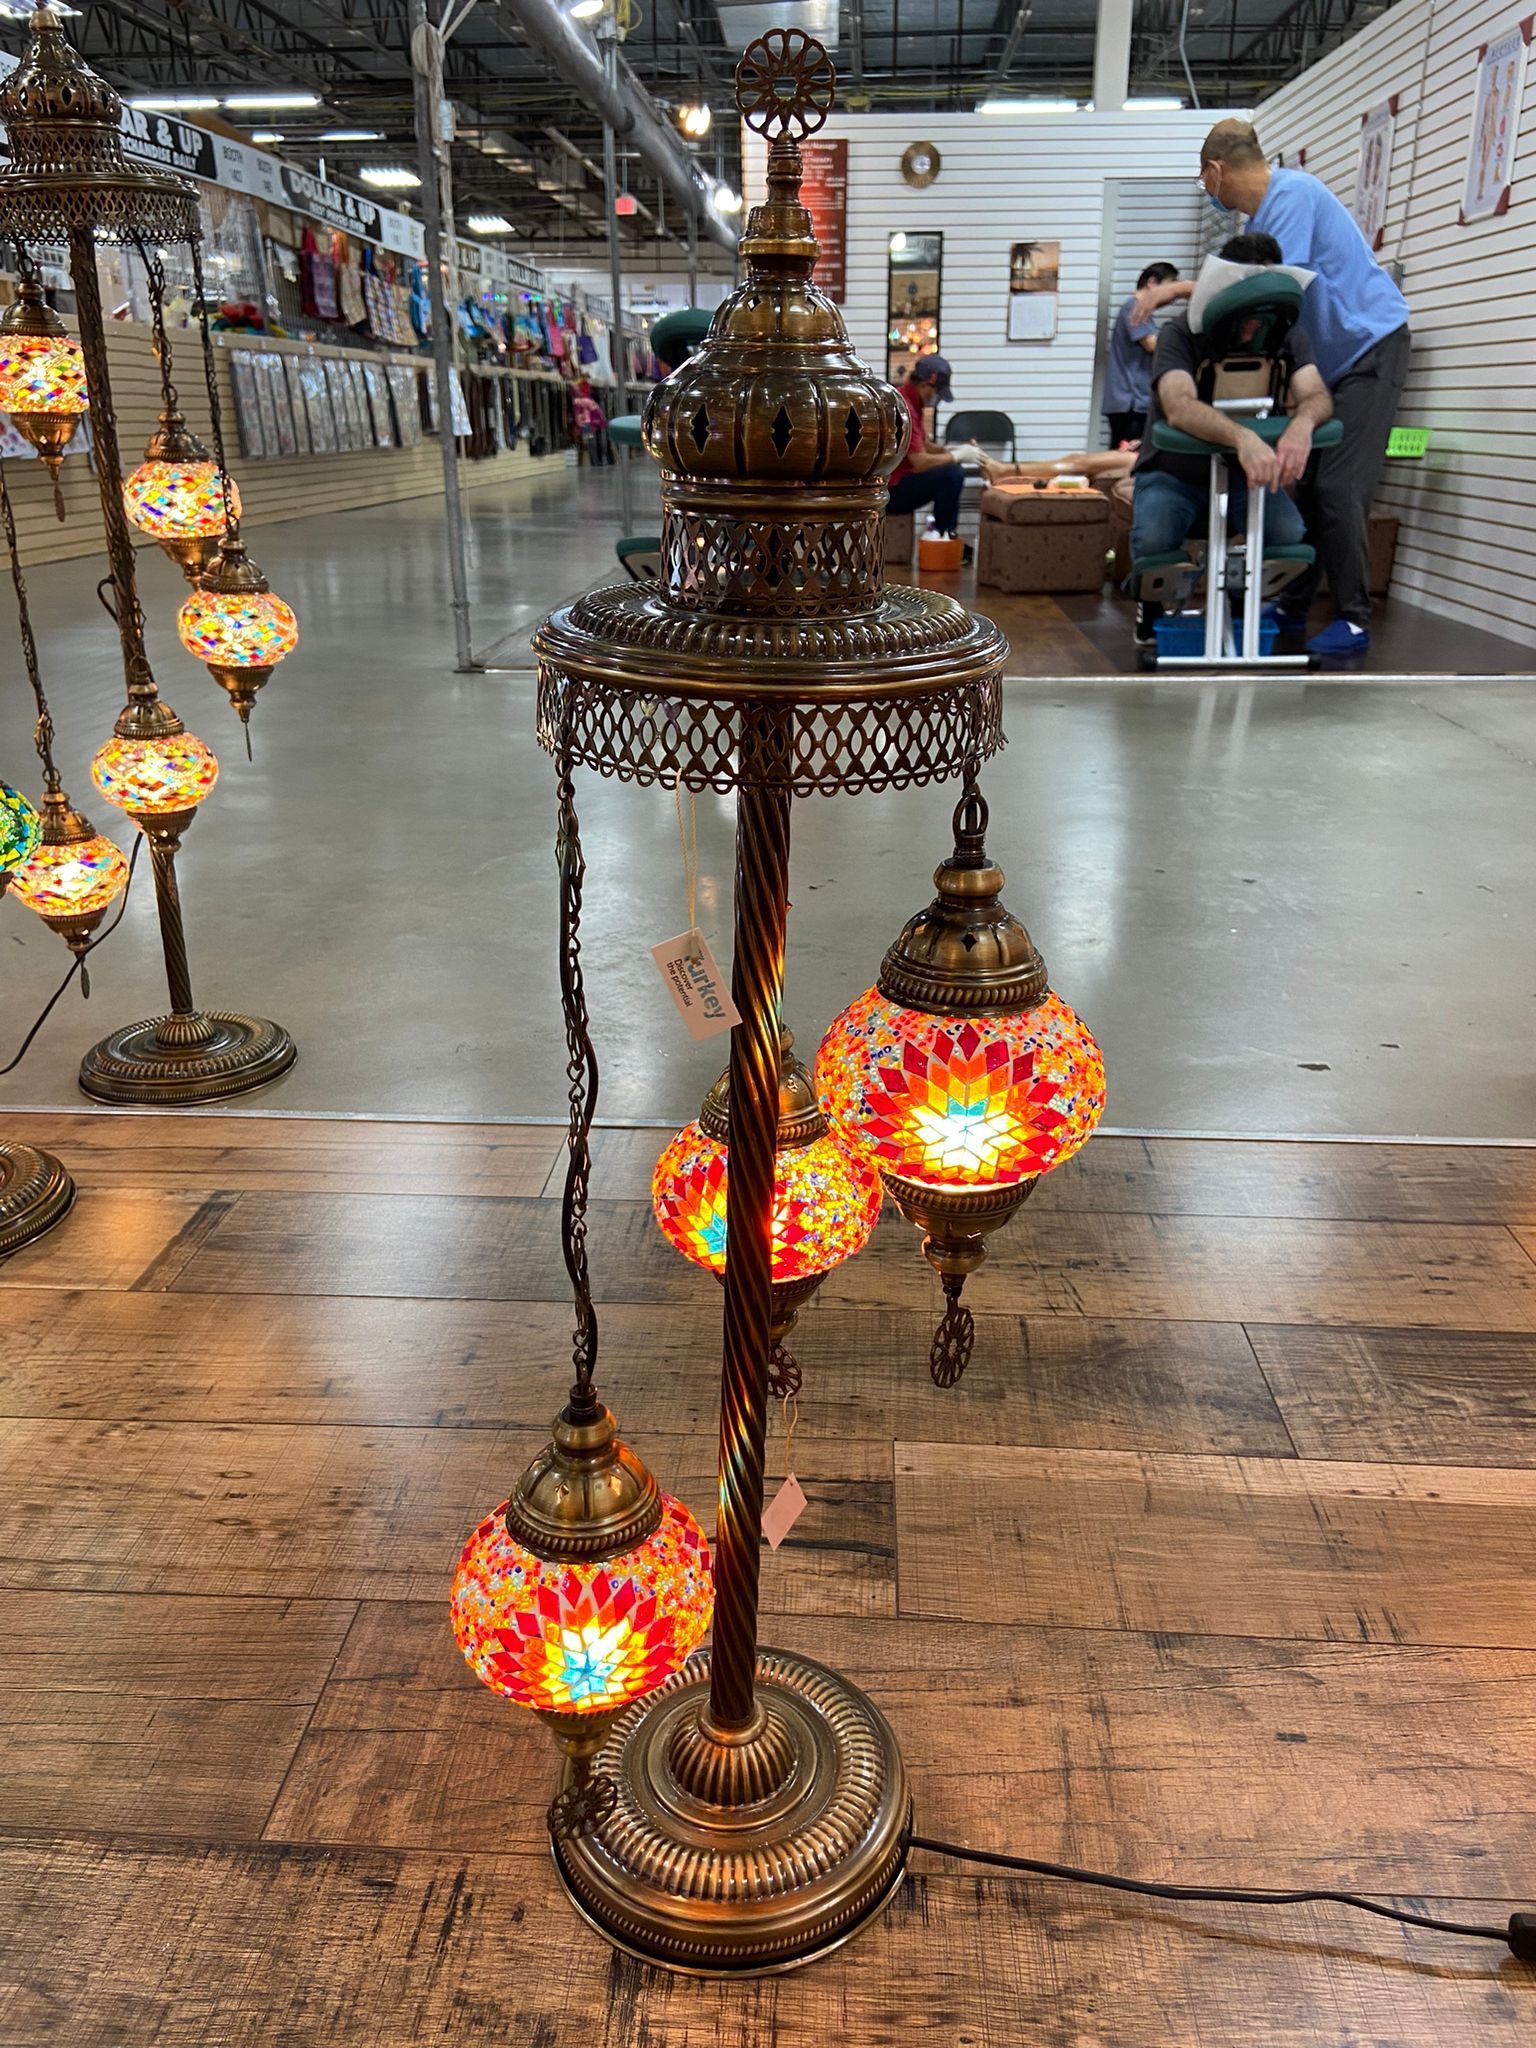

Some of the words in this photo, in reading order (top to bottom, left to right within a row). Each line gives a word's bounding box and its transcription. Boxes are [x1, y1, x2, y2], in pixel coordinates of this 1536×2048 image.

[156, 118, 175, 149] &
[178, 125, 203, 157] UP
[289, 170, 343, 213] DOLLAR
[345, 196, 358, 219] &
[358, 202, 376, 226] UP
[666, 962, 677, 976] the
[674, 958, 693, 990] Discover
[671, 976, 693, 1007] potential
